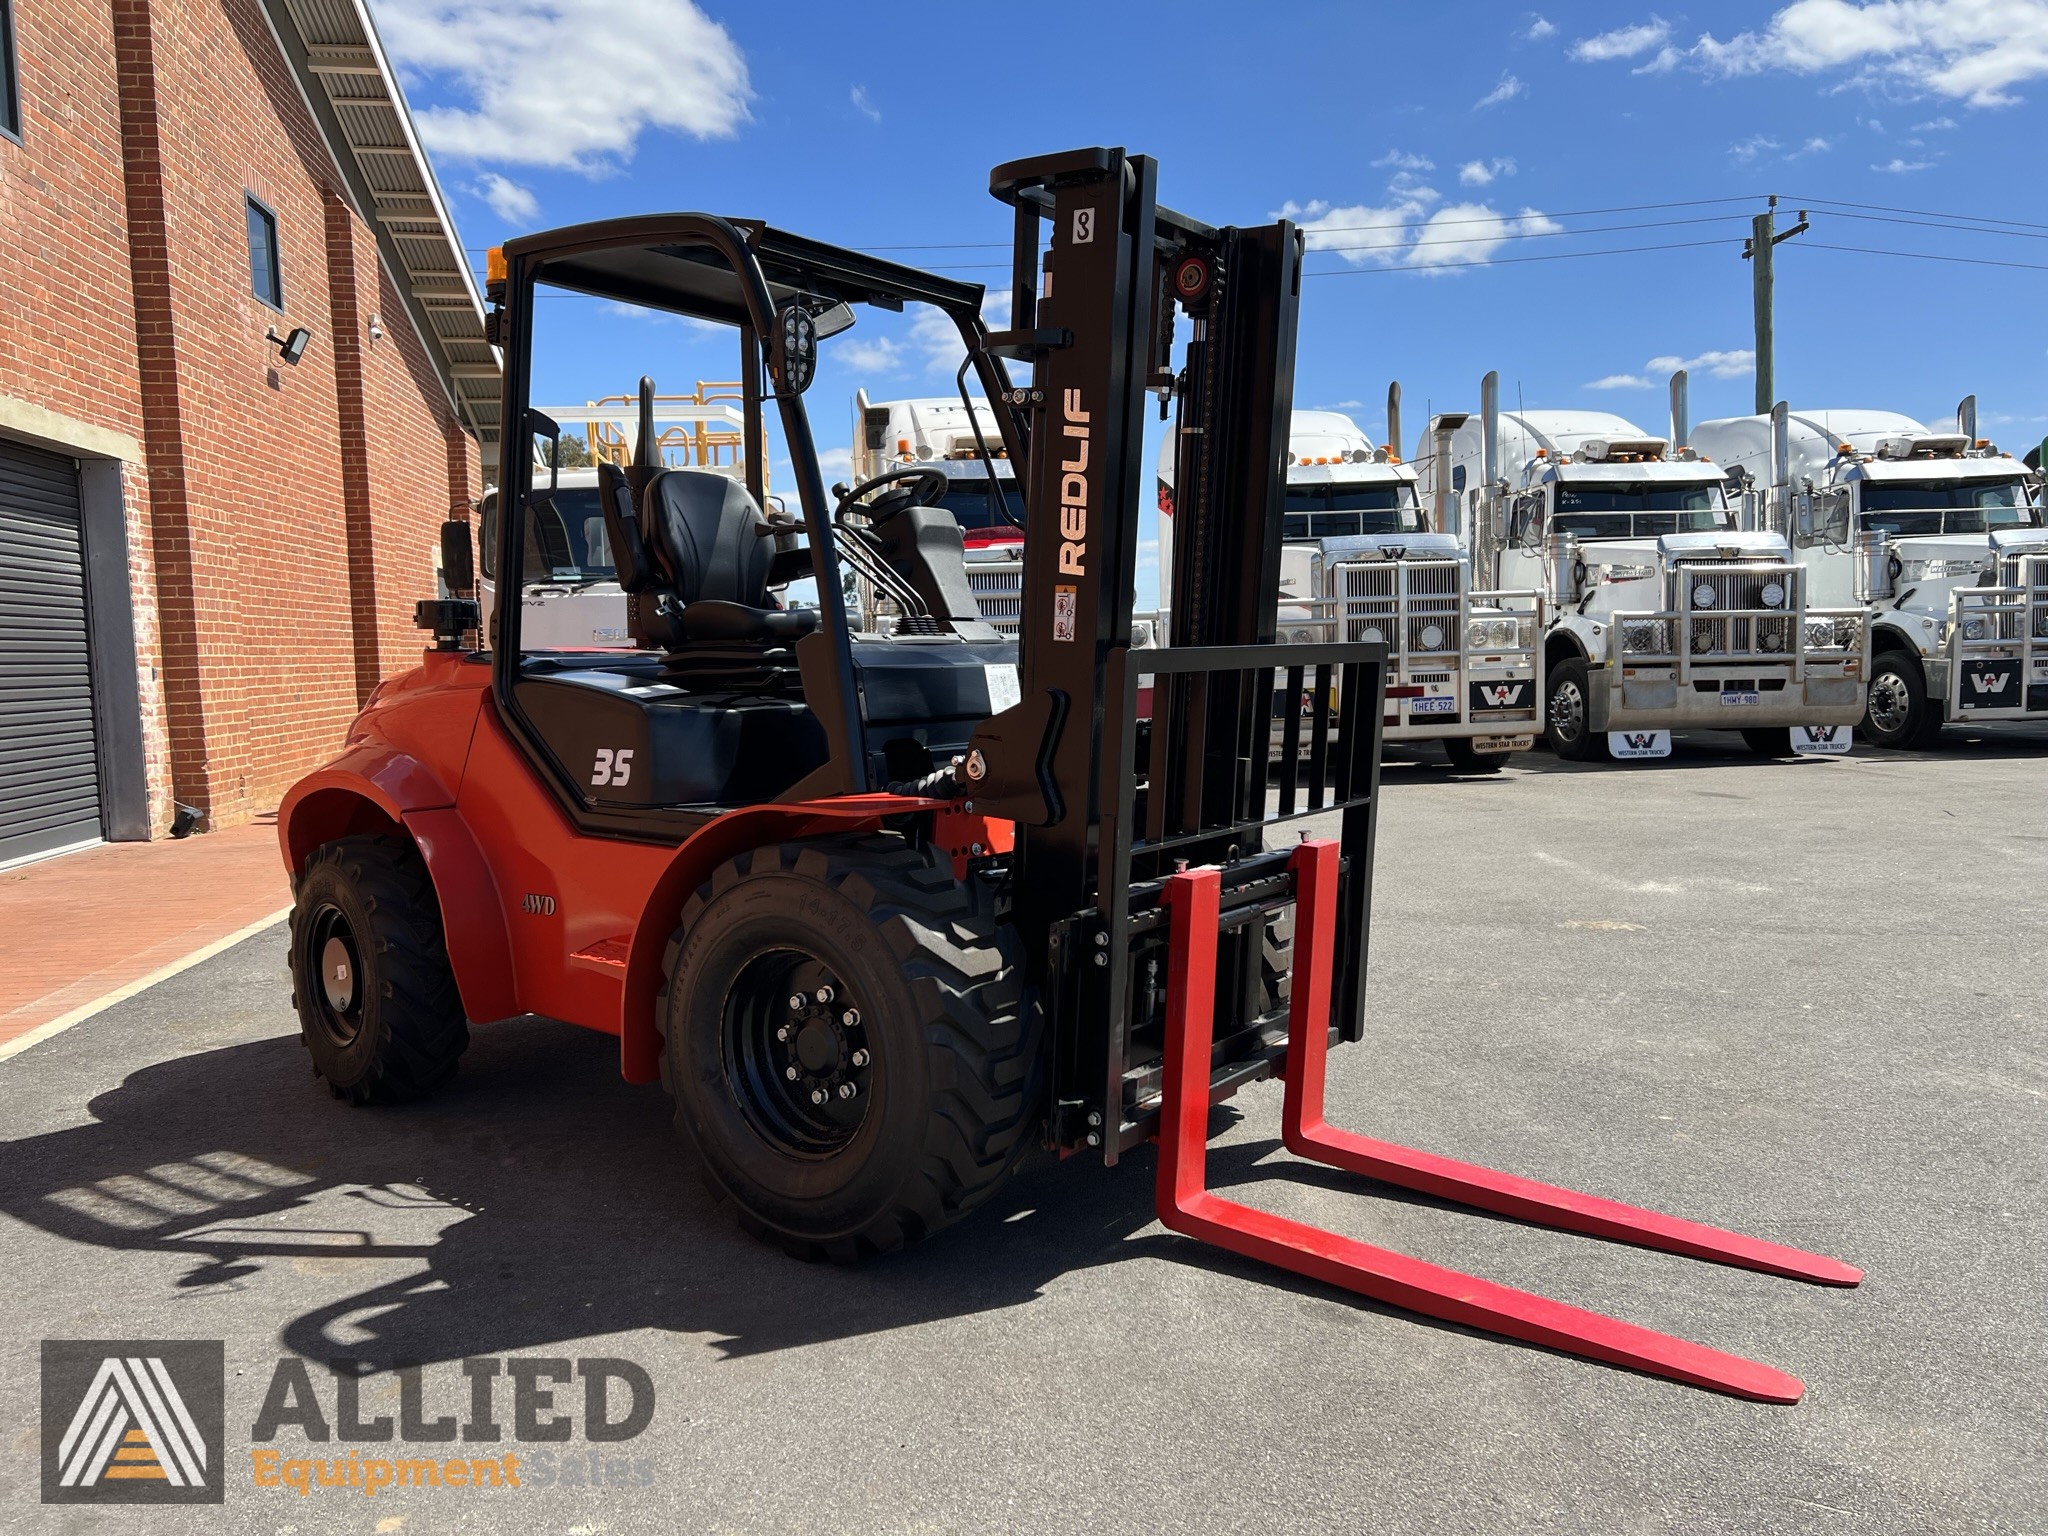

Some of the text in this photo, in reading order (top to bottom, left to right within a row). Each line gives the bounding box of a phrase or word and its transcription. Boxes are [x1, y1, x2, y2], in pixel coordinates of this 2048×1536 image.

[1058, 388, 1090, 577] REDLIF
[592, 628, 629, 642] ISU
[1475, 742, 1498, 750] WESTERN
[1498, 741, 1511, 749] STAR
[590, 748, 635, 787] 35
[521, 893, 556, 916] 4WD
